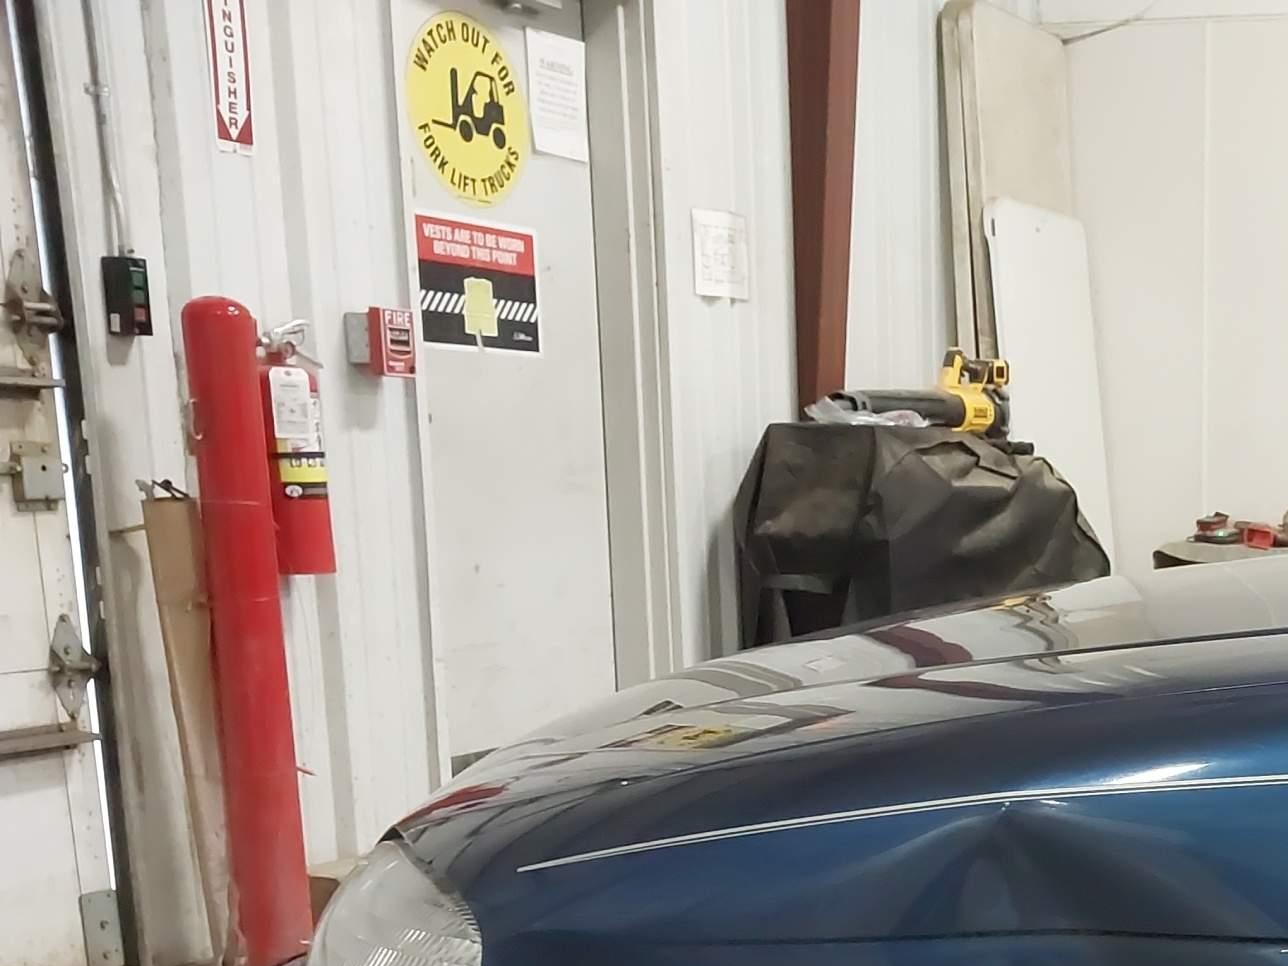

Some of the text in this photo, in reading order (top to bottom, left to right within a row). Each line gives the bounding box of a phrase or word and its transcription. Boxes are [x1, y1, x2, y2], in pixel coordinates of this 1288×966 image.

[413, 20, 516, 97] WATCH OUT FOR
[418, 123, 519, 197] FORK LIFT TRUCKS
[422, 222, 452, 241] VESTS
[454, 228, 472, 244] ARE
[472, 231, 485, 246] TO
[485, 233, 498, 248] BE
[433, 240, 517, 266] BEYOND THIS POINT
[384, 310, 411, 327] FIRE
